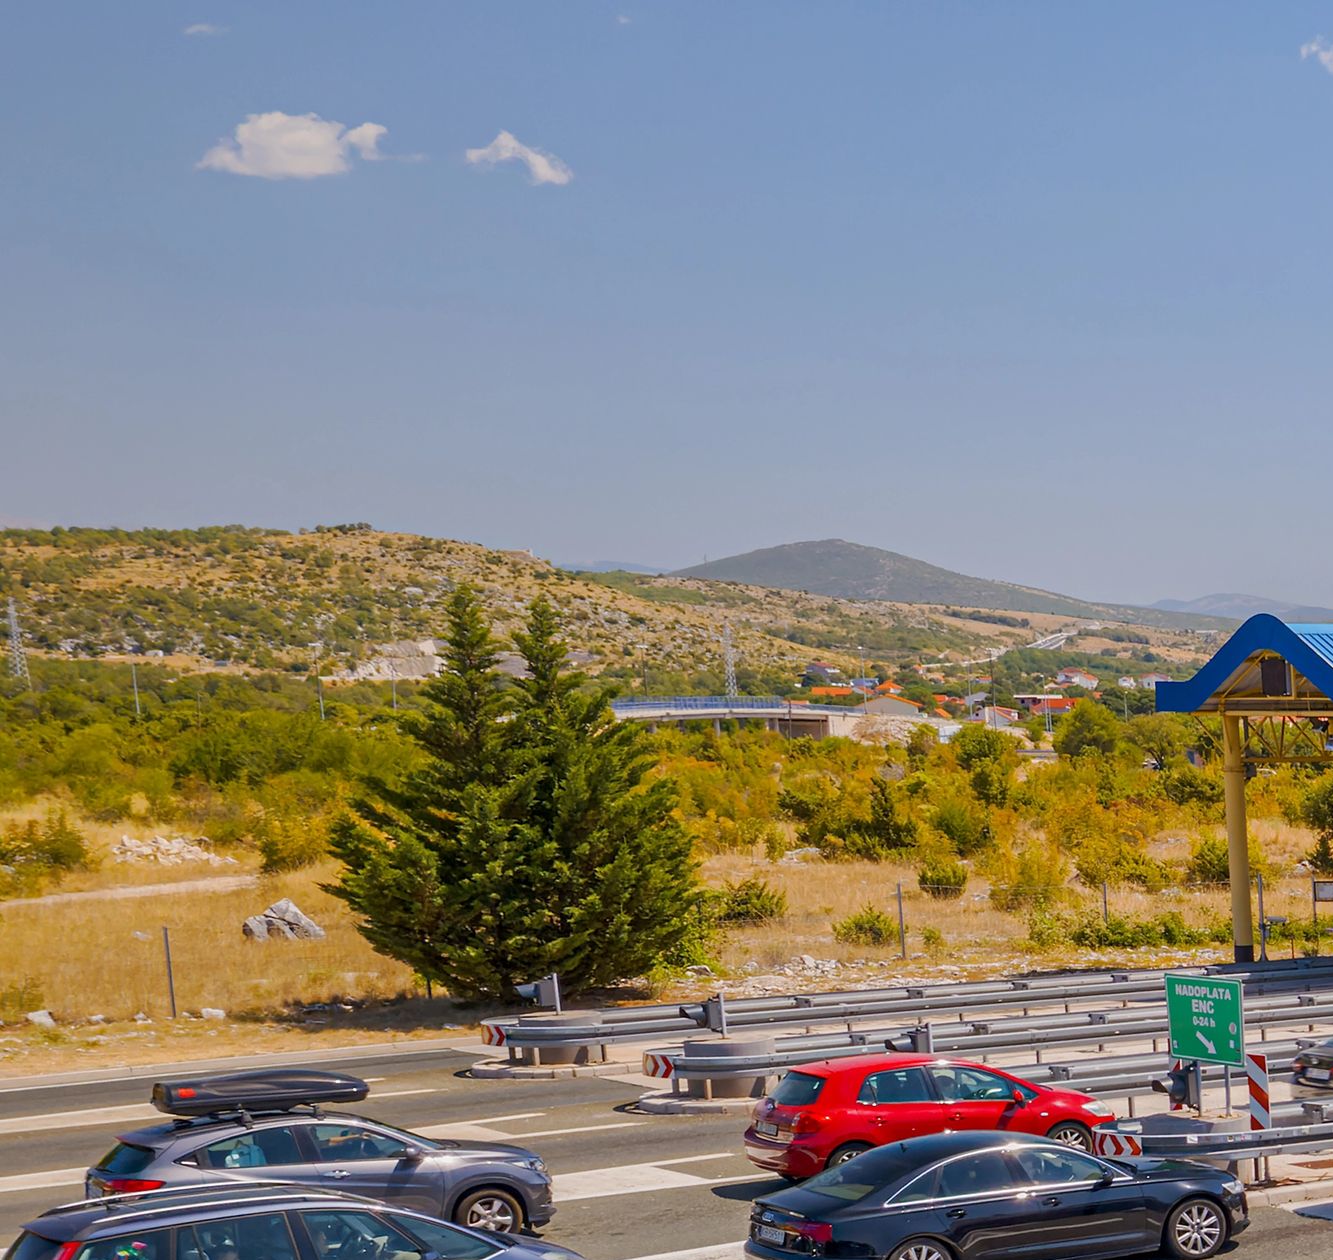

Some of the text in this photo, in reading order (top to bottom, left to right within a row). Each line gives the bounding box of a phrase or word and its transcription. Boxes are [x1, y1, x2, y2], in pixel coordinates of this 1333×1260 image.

[1175, 984, 1231, 1000] NADOPLATA
[1191, 999, 1215, 1014] ENC
[1192, 1016, 1216, 1027] 0-24 h
